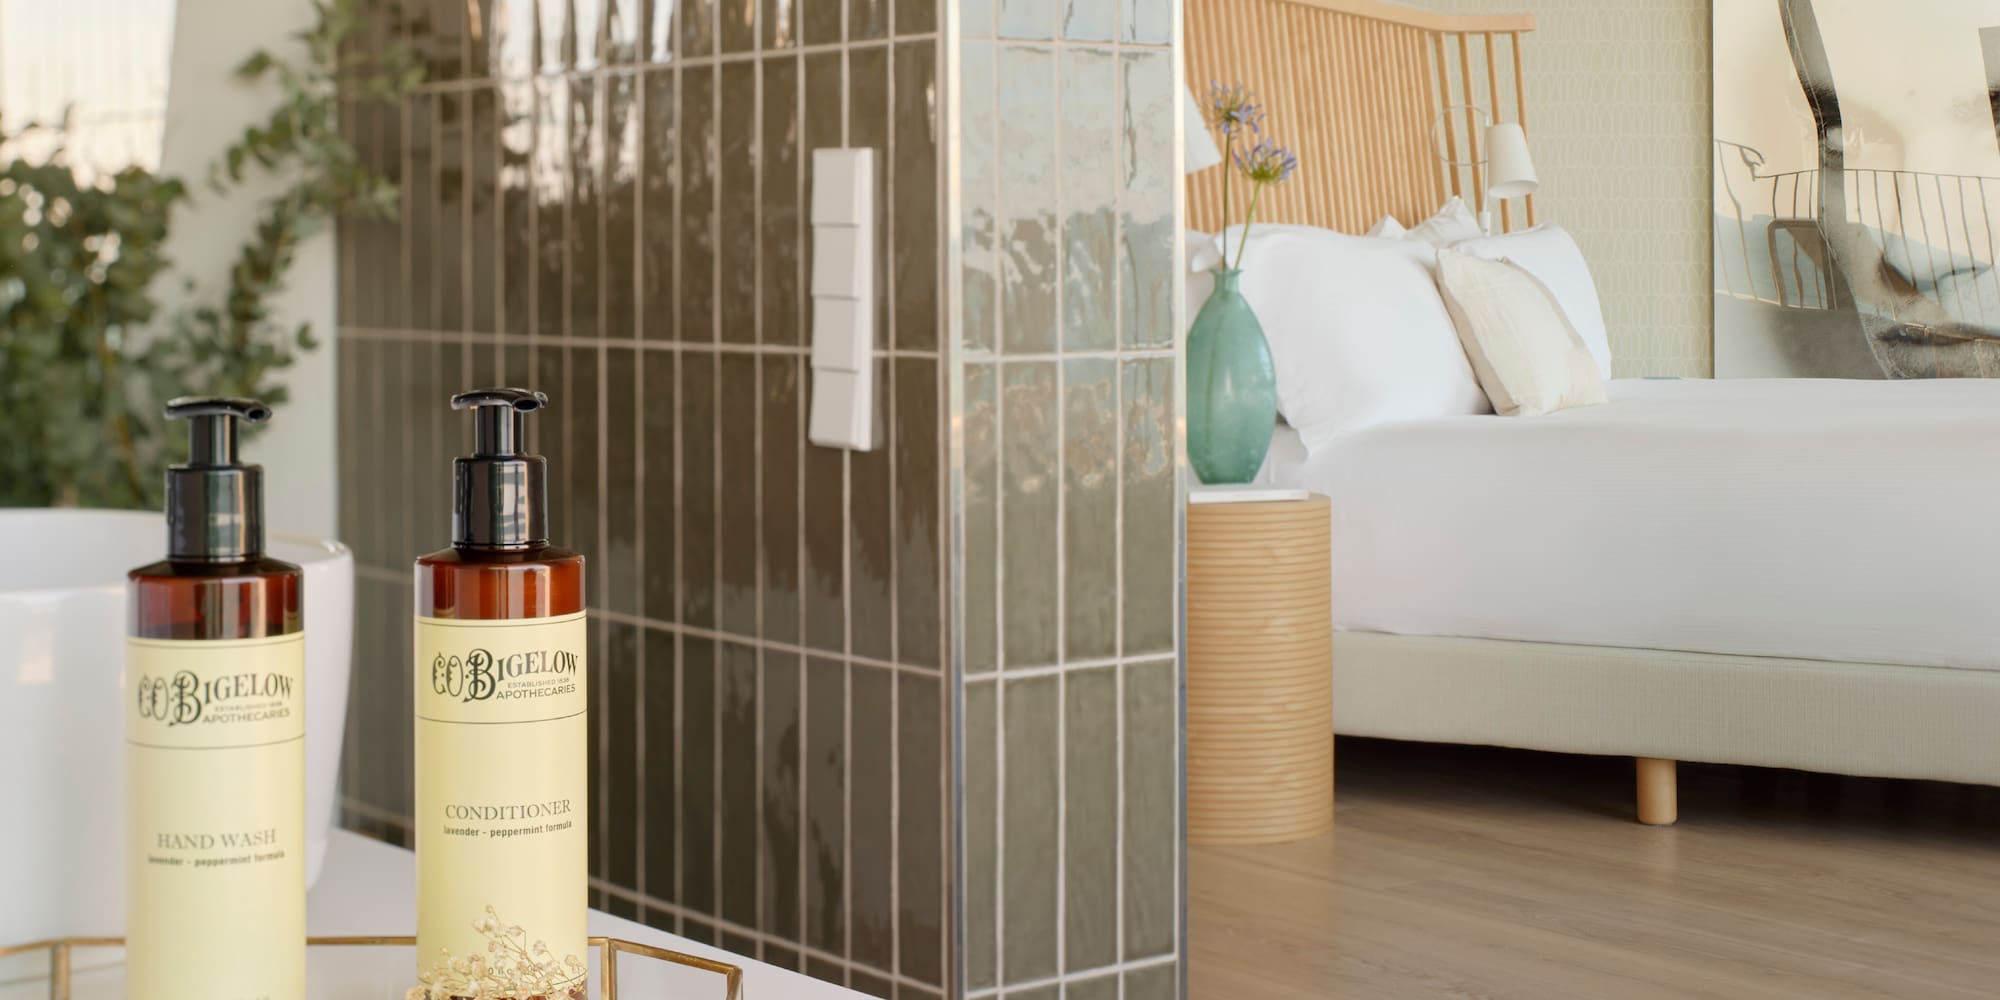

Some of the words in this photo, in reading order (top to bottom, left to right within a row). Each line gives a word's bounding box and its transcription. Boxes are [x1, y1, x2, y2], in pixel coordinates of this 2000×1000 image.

[496, 683, 576, 699] APOTHECARIES
[507, 679, 556, 689] ESTABLISHED
[202, 707, 290, 723] APOTHECARIES
[445, 799, 571, 820] CONDITIONER
[443, 825, 479, 836] lavender
[490, 824, 543, 838] peppermint
[545, 820, 572, 833] formula
[157, 833, 215, 850] HAND
[220, 828, 277, 848] WASH
